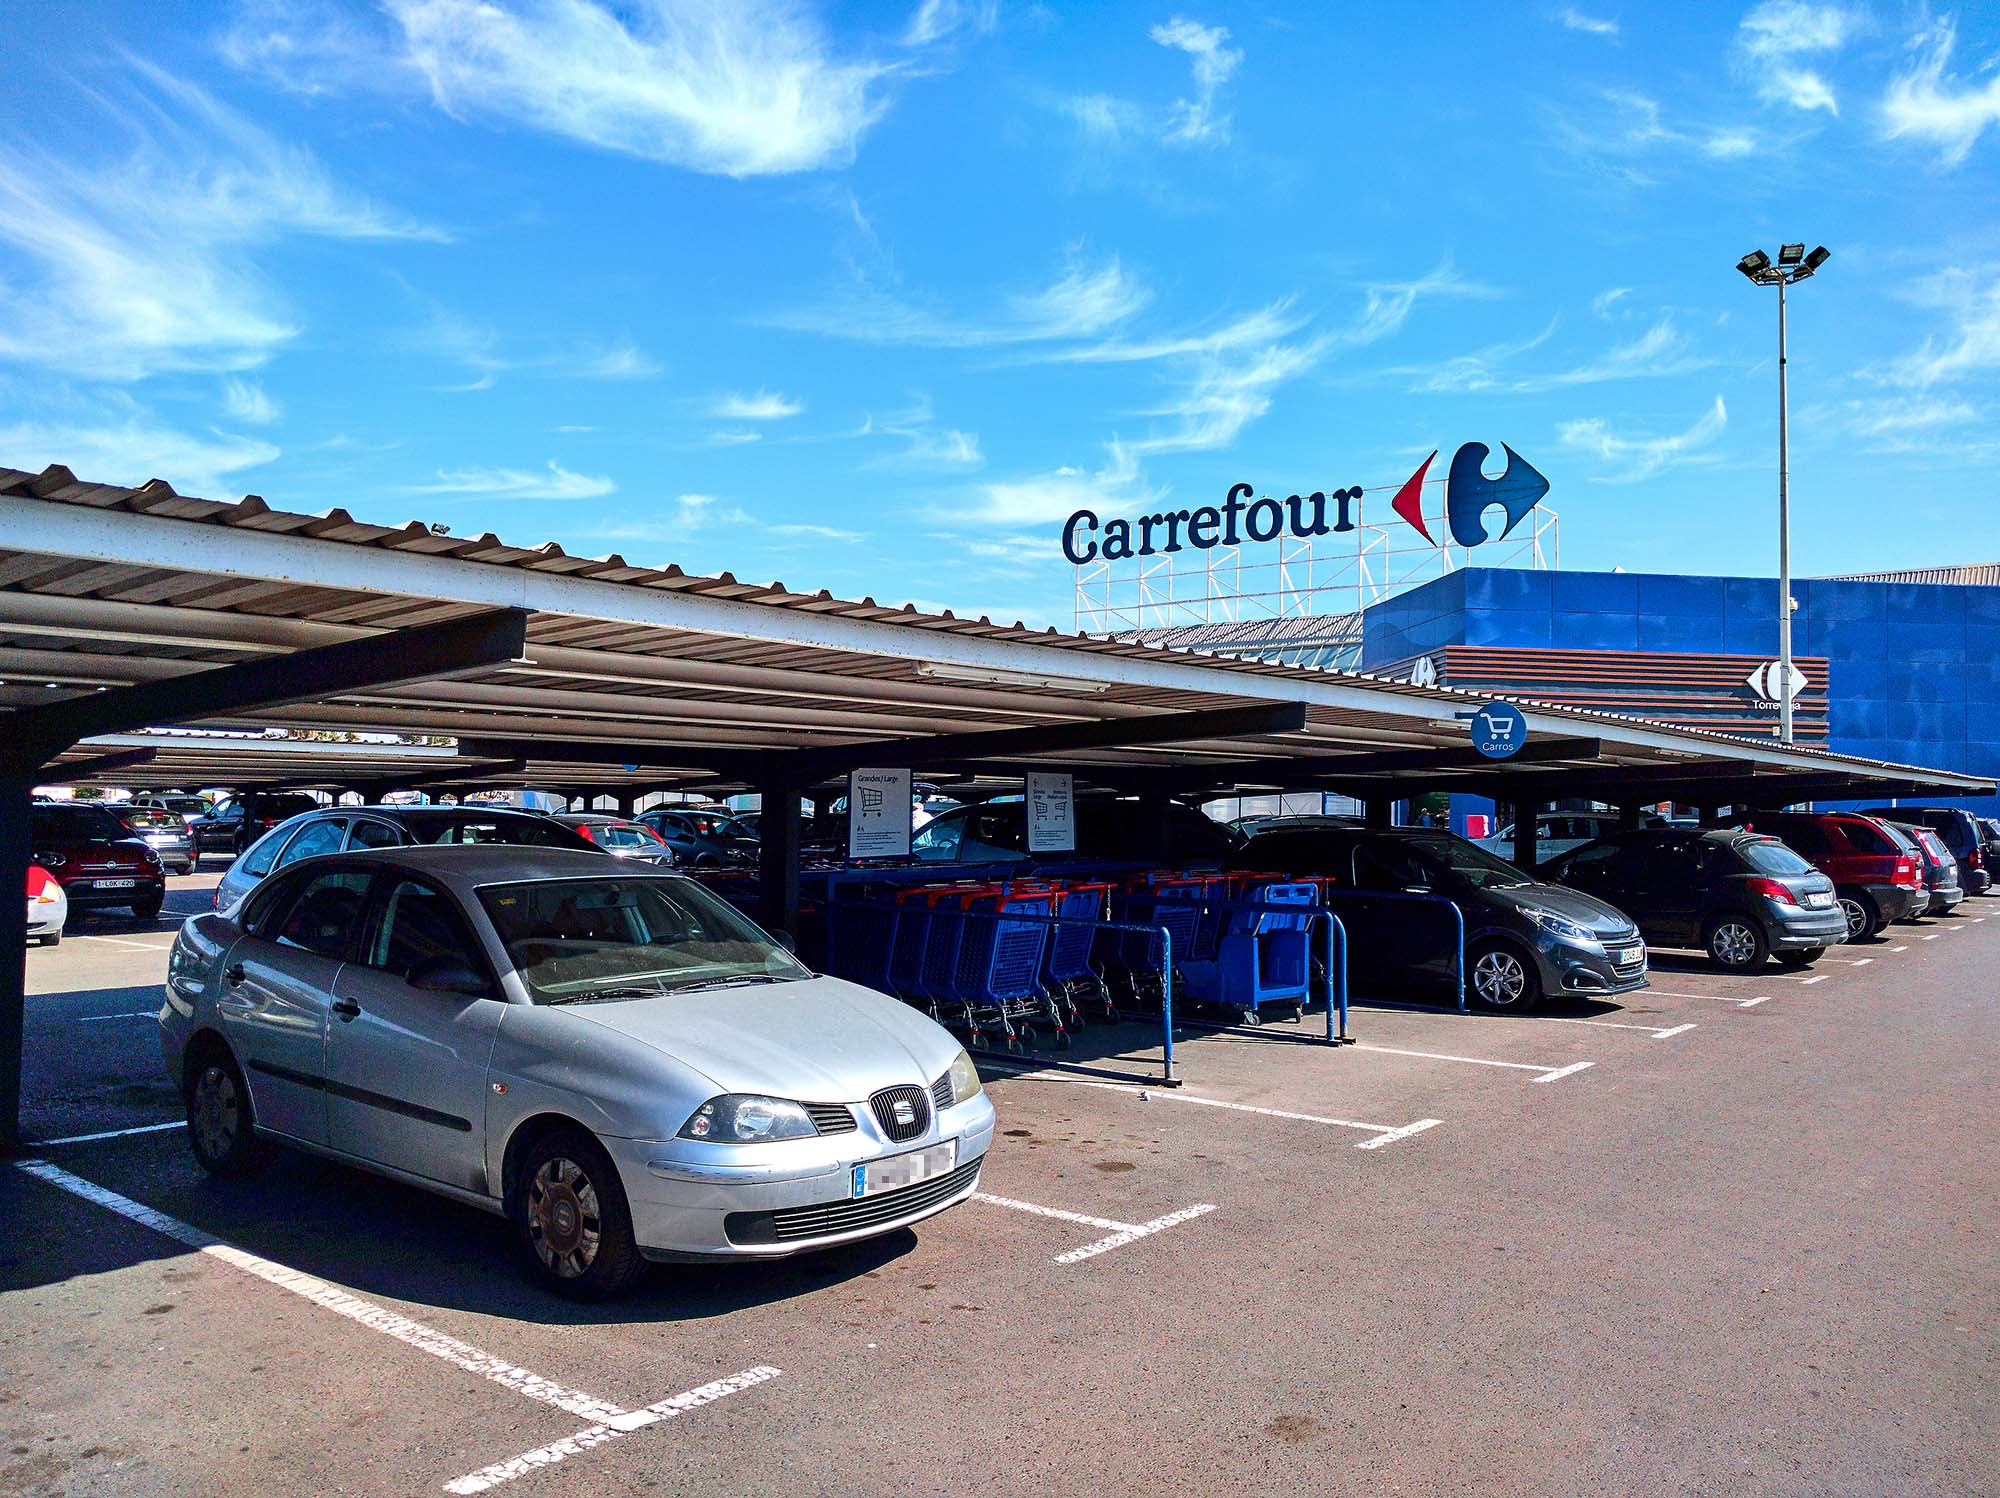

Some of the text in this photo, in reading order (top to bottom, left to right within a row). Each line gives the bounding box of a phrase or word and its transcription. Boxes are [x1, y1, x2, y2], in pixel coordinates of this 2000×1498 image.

[1062, 483, 1363, 565] Carrefour
[1752, 699, 1801, 712] Torrevja
[1482, 742, 1514, 751] Carros
